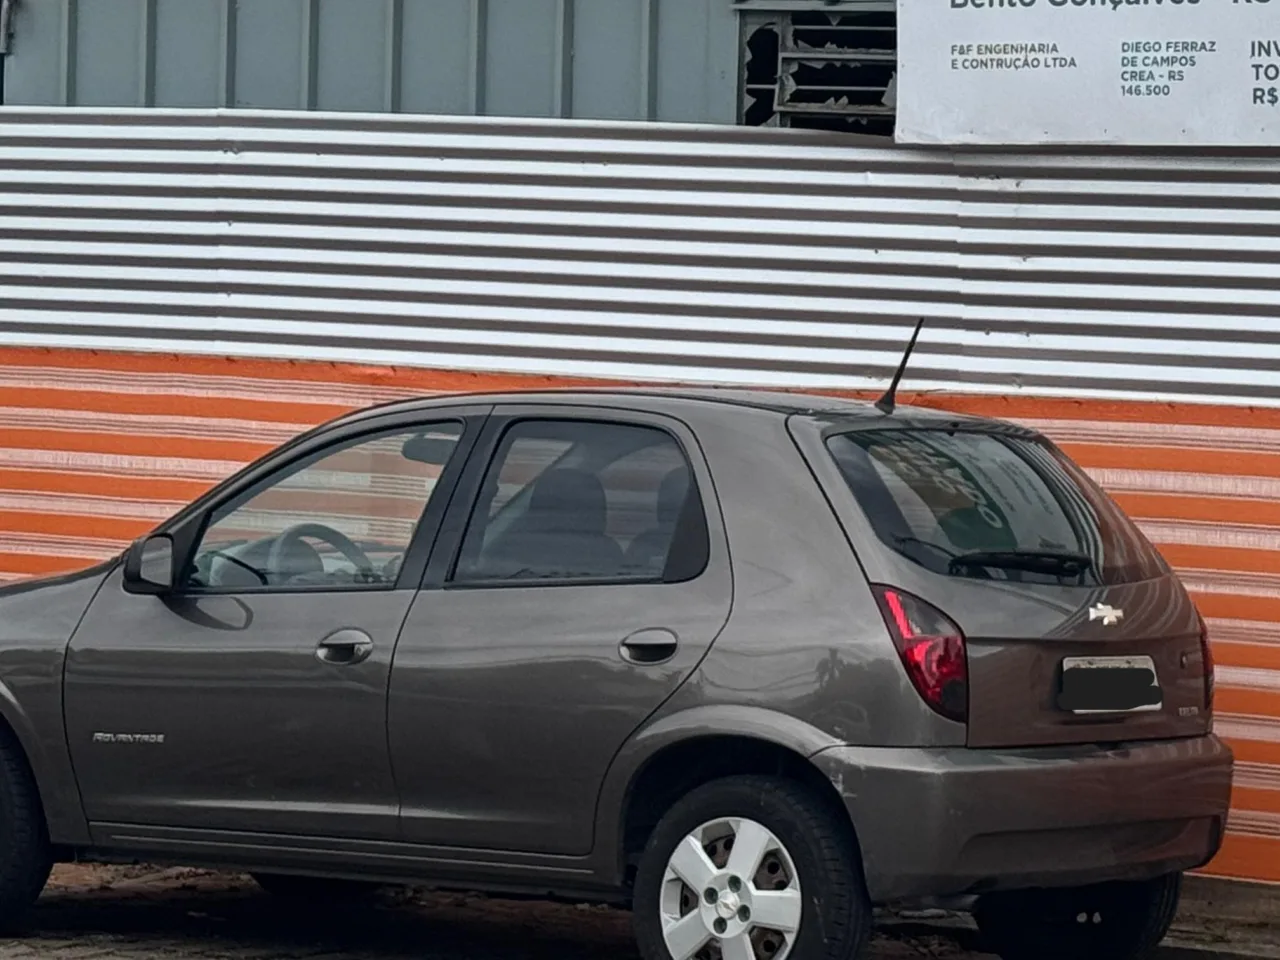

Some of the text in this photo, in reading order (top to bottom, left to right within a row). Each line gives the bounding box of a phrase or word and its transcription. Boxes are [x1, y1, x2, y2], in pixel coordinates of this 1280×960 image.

[951, 43, 1059, 55] F&F ENGENHARIA
[1122, 41, 1216, 53] DIEGO FERRAZ
[951, 59, 958, 69] E
[1044, 57, 1077, 68] LTDA
[1121, 56, 1196, 67] DE CAMPOS
[1121, 71, 1155, 81] CREA
[1168, 70, 1184, 81] RS
[1121, 85, 1170, 96] 146.500
[1253, 87, 1278, 106] R$
